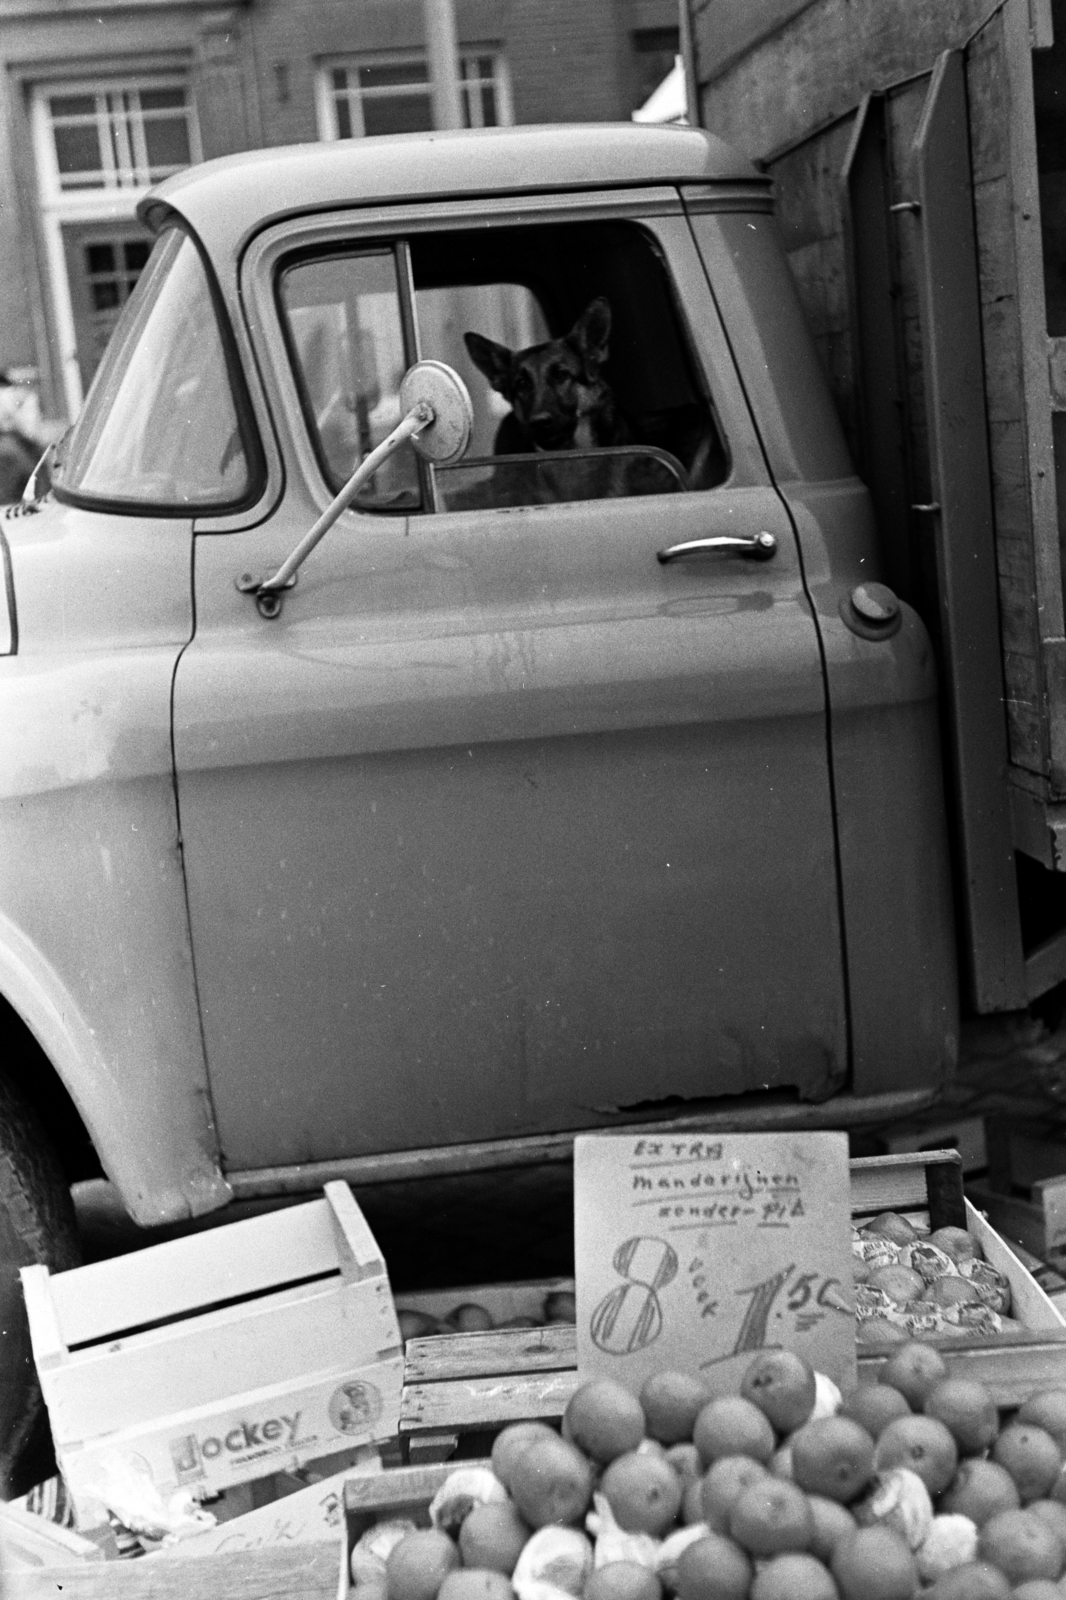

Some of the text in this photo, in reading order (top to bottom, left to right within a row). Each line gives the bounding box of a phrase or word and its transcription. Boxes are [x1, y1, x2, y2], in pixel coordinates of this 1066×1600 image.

[634, 1140, 723, 1161] EXTRA
[590, 1236, 679, 1356] 8
[177, 1410, 302, 1472] Jockey
